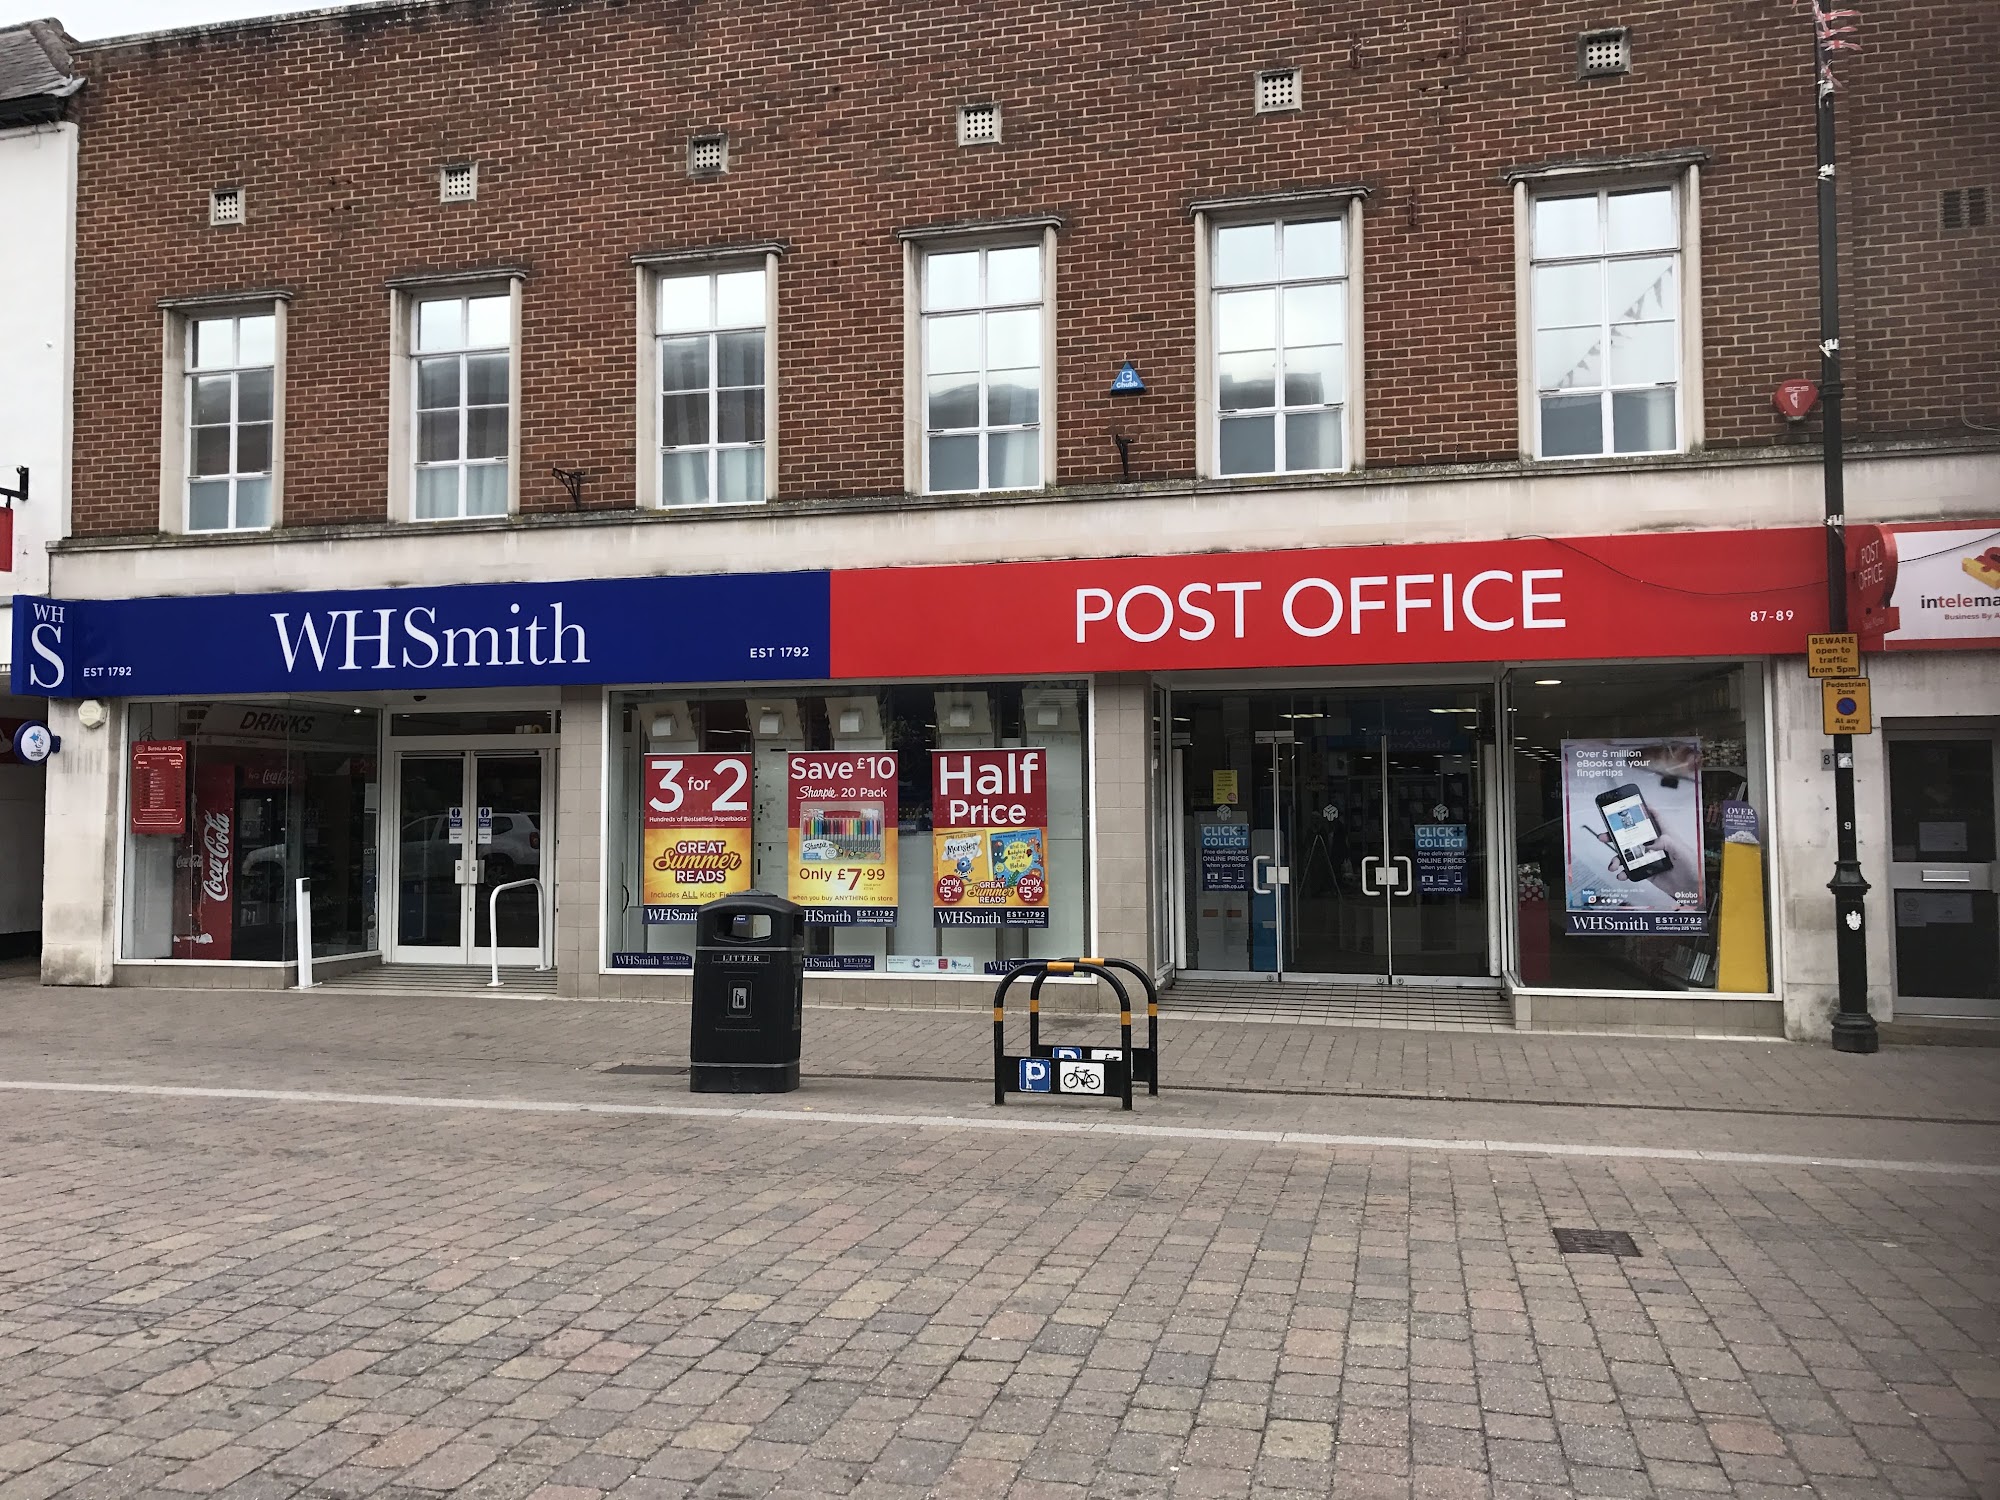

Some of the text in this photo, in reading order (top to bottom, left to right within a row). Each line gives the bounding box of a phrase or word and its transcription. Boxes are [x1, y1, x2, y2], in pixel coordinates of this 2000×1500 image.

[1861, 540, 1880, 566] POST
[1858, 562, 1884, 590] OFFICE
[1076, 569, 1566, 644] POST OFFICE
[33, 603, 65, 623] WH
[1750, 610, 1794, 622] 87-89
[1982, 613, 1992, 621] By
[270, 602, 590, 673] WHSmith
[30, 624, 65, 689] S
[750, 646, 810, 658] EST 1792
[1819, 656, 1847, 664] traffic
[83, 666, 132, 677] EST 1792
[1836, 666, 1856, 674] 5pm
[240, 711, 315, 734] DRINKS
[1576, 750, 1599, 758] Over
[1610, 749, 1641, 757] million
[791, 756, 896, 780] Save £10
[1576, 759, 1613, 767] eBooks
[1628, 759, 1650, 768] your
[940, 753, 1039, 795] Half
[1576, 769, 1623, 778] fingertips
[649, 758, 748, 812] 3 for 2
[796, 785, 887, 800] Sharpie 20 Pack
[950, 798, 1026, 824] Price
[1727, 807, 1754, 815] OVER
[714, 815, 747, 823] Paperbacks
[1844, 821, 1852, 829] 9
[1203, 837, 1247, 846] COLLECT
[1417, 839, 1464, 848] COLLECT
[676, 842, 725, 854] GREAT
[947, 843, 977, 855] Monster
[654, 848, 741, 870] Summer
[676, 870, 725, 882] READS
[799, 868, 832, 882] Only
[940, 878, 960, 886] Only
[1020, 877, 1041, 886] Only
[651, 891, 680, 899] Includes
[681, 891, 698, 899] ALL
[967, 885, 1014, 897] Summer
[647, 908, 698, 921] WHSmit
[803, 909, 851, 923] HSmith
[938, 910, 1001, 924] WHSmith
[1572, 915, 1649, 931] WHSmith
[615, 955, 659, 966] WHSmith
[722, 954, 760, 962] LITTER
[1025, 1061, 1046, 1089] P
